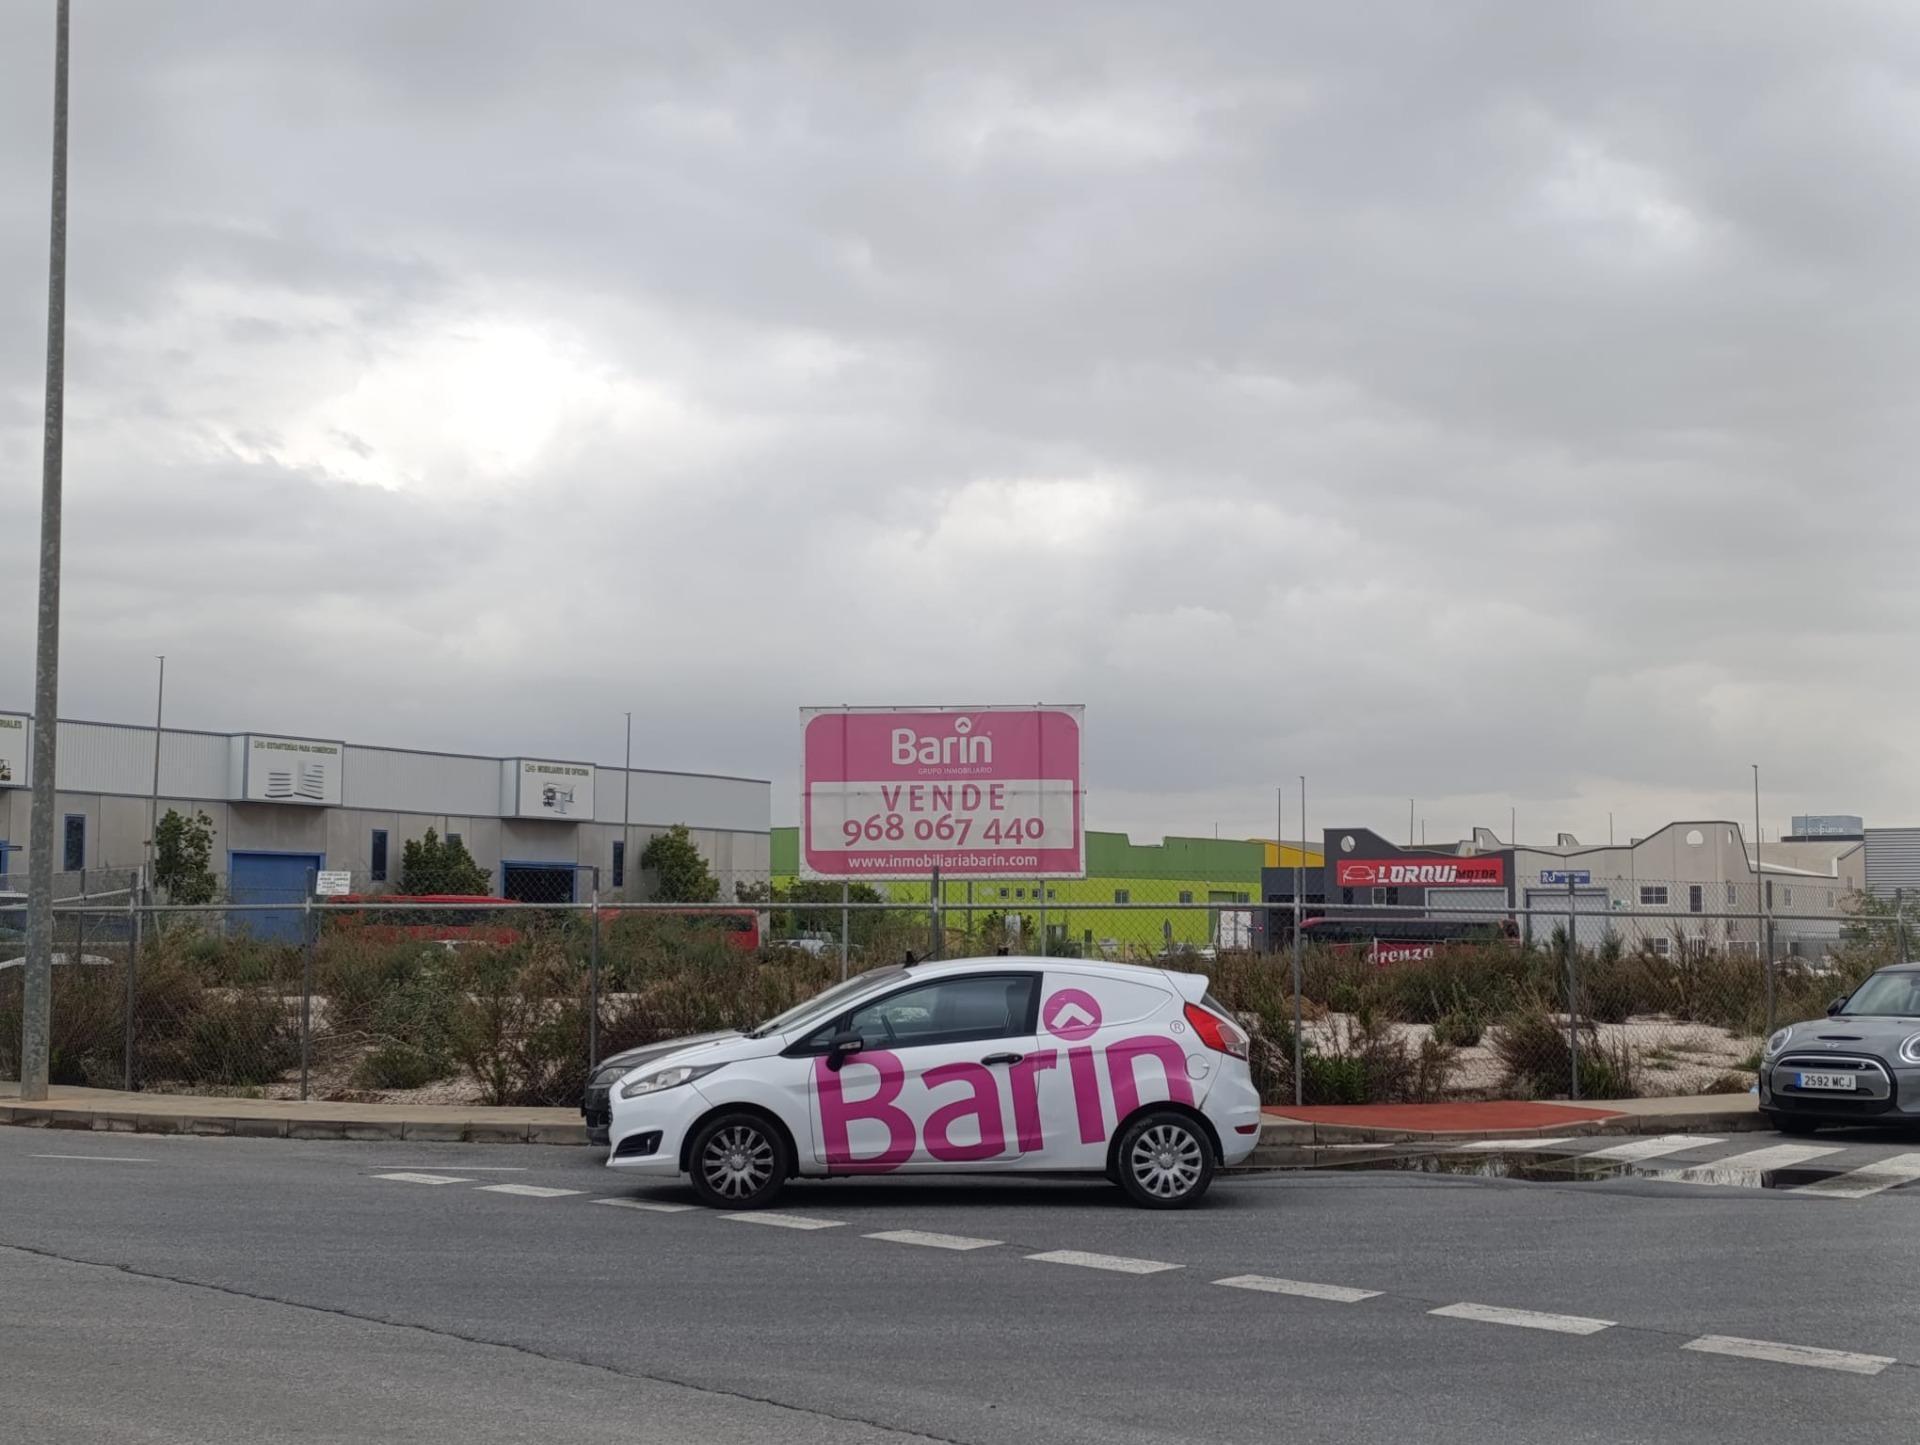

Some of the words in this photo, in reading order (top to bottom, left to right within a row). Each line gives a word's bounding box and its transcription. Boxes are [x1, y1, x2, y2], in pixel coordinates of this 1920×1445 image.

[891, 717, 993, 766] Barin
[918, 767, 943, 776] GRUPO
[944, 766, 993, 775] INMOBILIARIO
[880, 783, 1005, 812] VENDE
[842, 813, 905, 847] 968
[914, 813, 974, 846] 067
[982, 817, 1045, 845] 440
[848, 853, 1039, 869] www.inmobiliariabarin.com
[1455, 869, 1497, 880] MOTOR
[815, 988, 1195, 1175] Barin
[1804, 1074, 1830, 1088] 2592
[1831, 1075, 1853, 1089] MCJ
